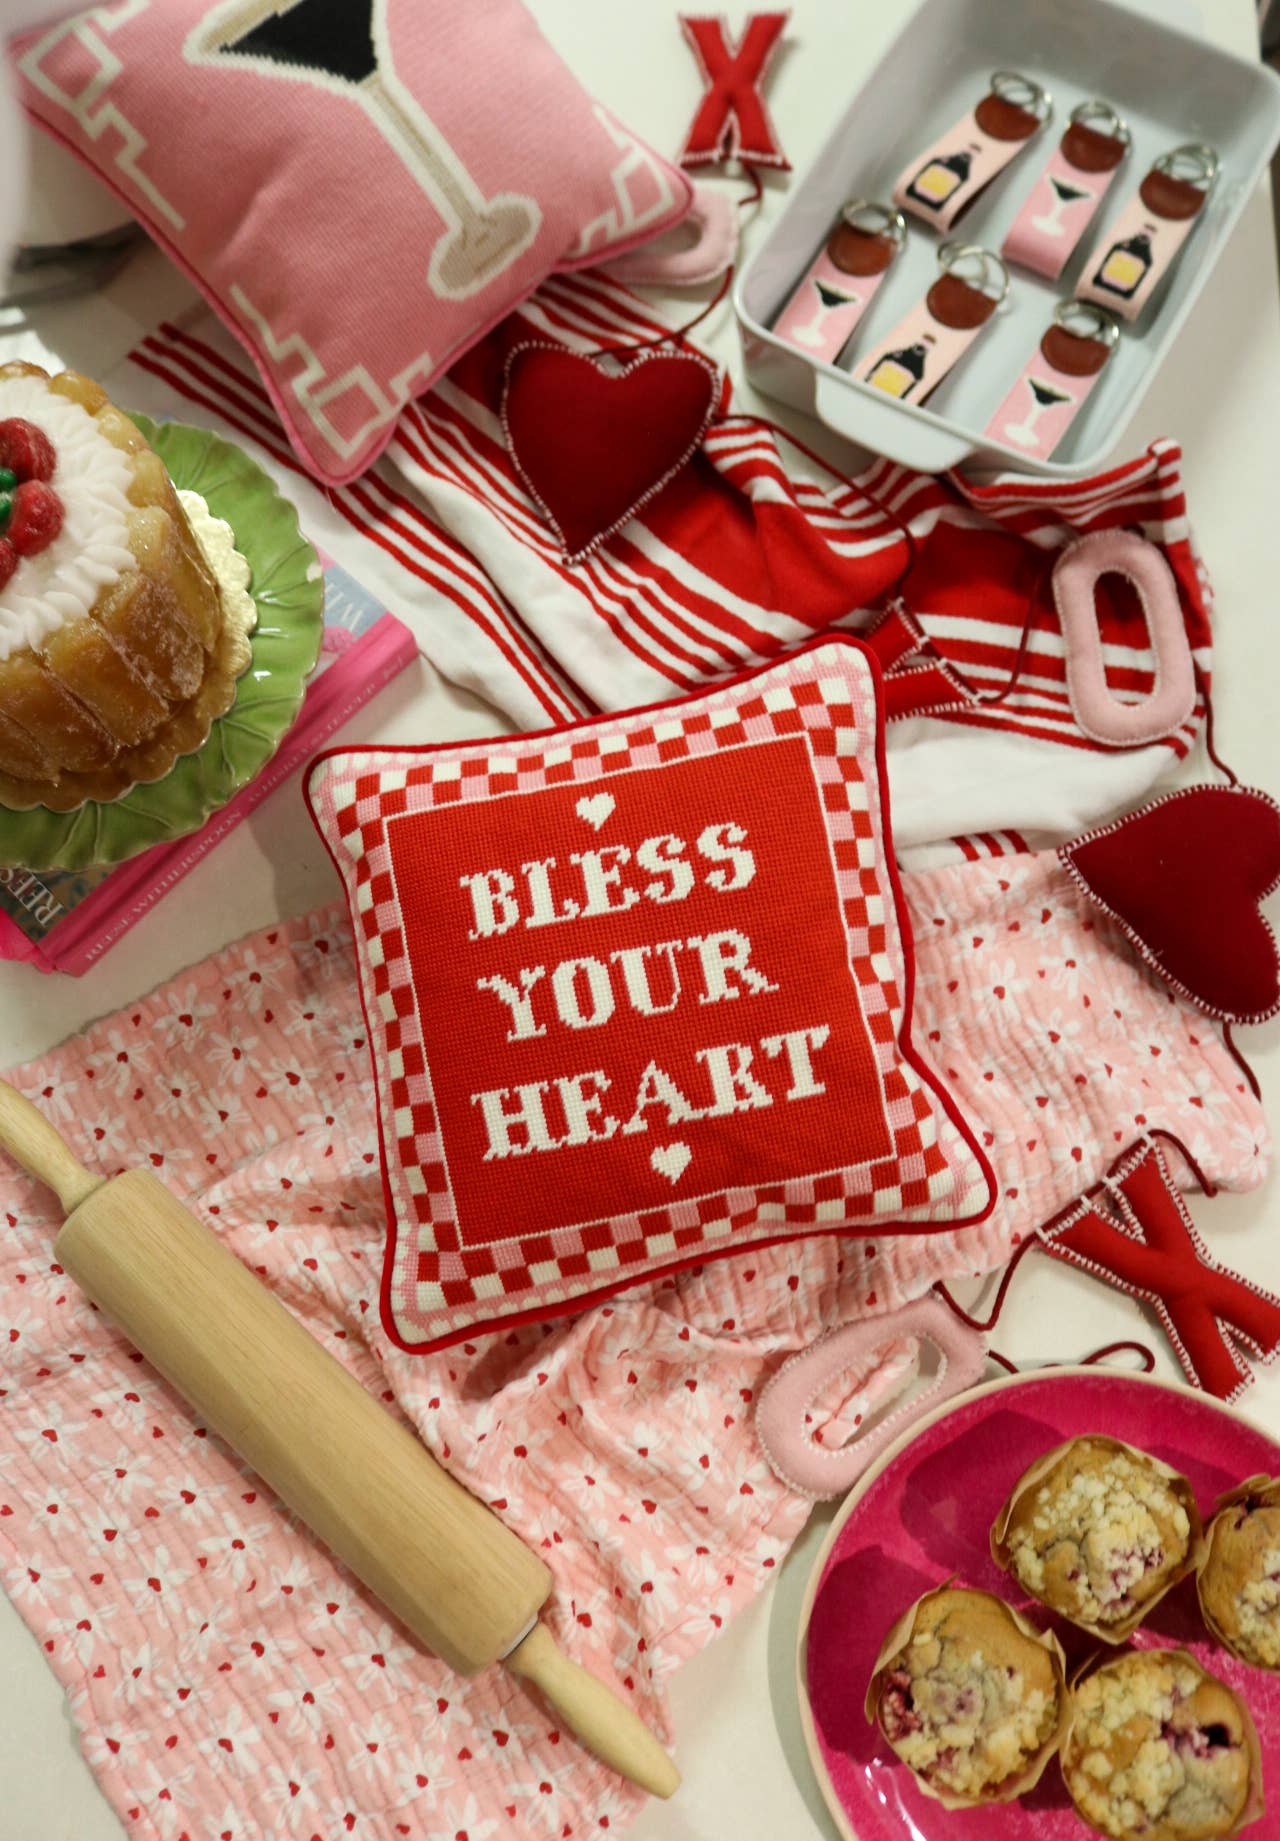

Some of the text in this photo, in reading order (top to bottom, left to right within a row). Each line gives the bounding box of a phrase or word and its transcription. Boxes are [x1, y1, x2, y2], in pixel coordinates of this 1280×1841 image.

[458, 821, 757, 942] BLESS
[476, 928, 780, 1043] YOUR
[470, 1024, 831, 1161] HEART
